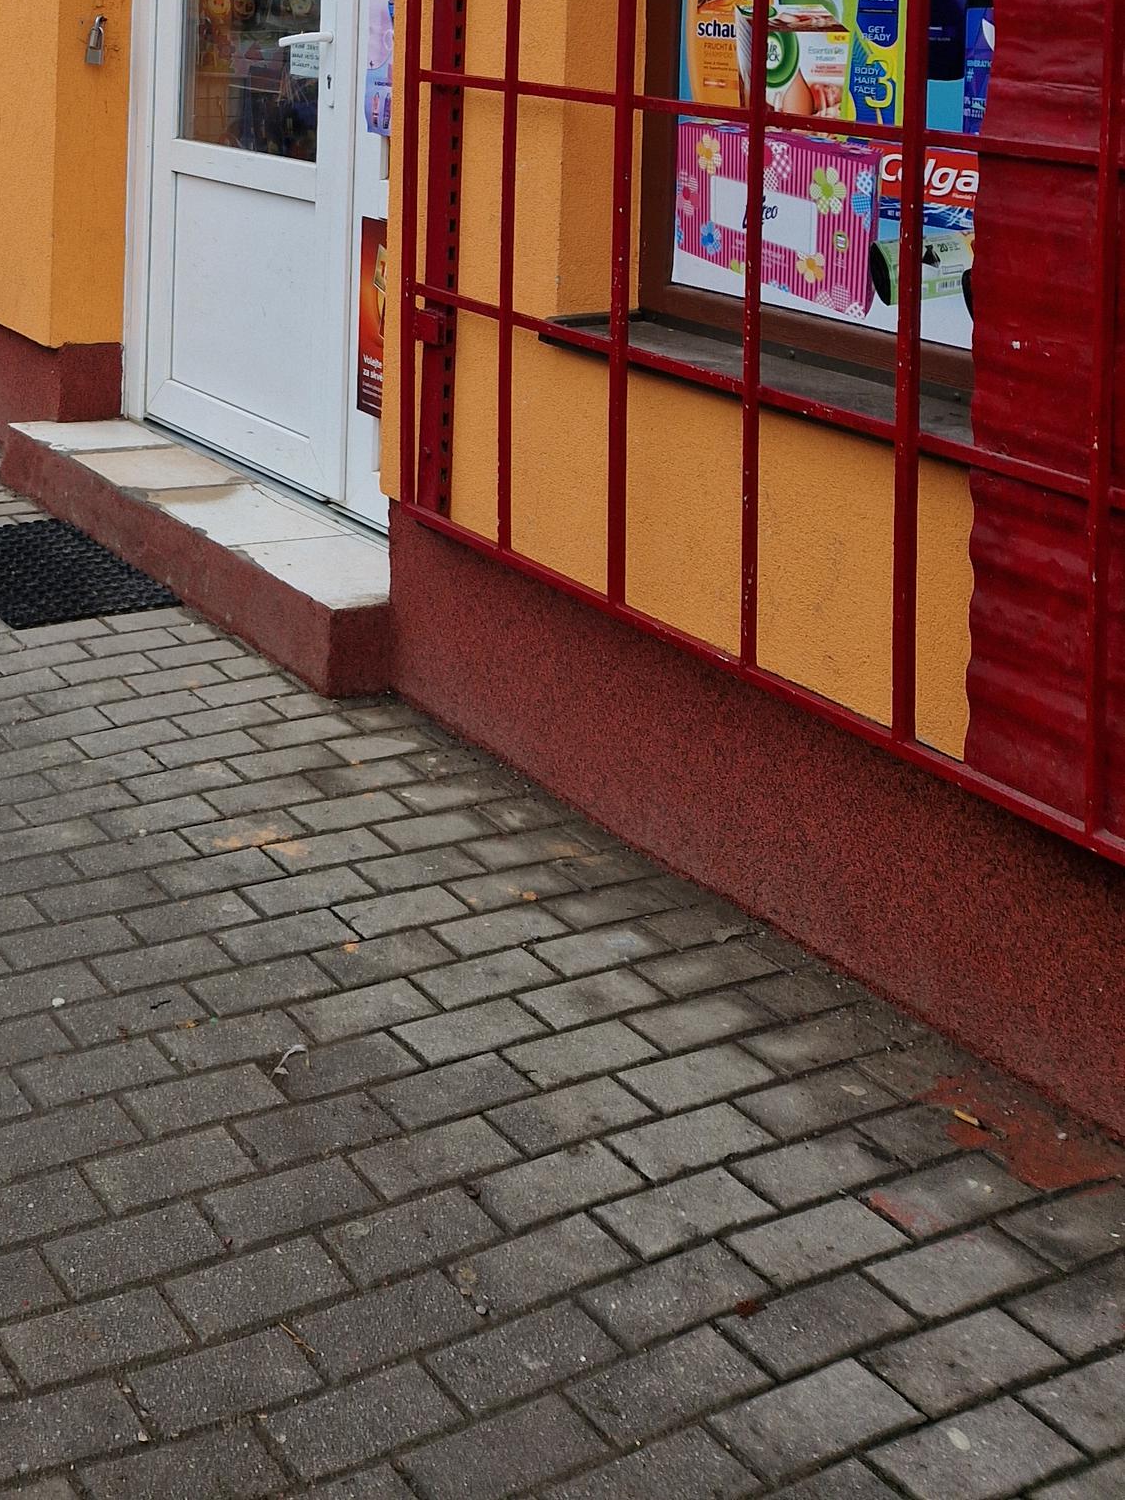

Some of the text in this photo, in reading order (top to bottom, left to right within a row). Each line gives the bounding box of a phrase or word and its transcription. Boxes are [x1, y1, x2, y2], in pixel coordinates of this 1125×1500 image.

[868, 26, 885, 34] GET
[861, 32, 891, 42] READY
[854, 66, 880, 75] BODY
[854, 76, 876, 85] HAIR
[854, 86, 877, 95] FACE
[881, 153, 979, 196] Clga
